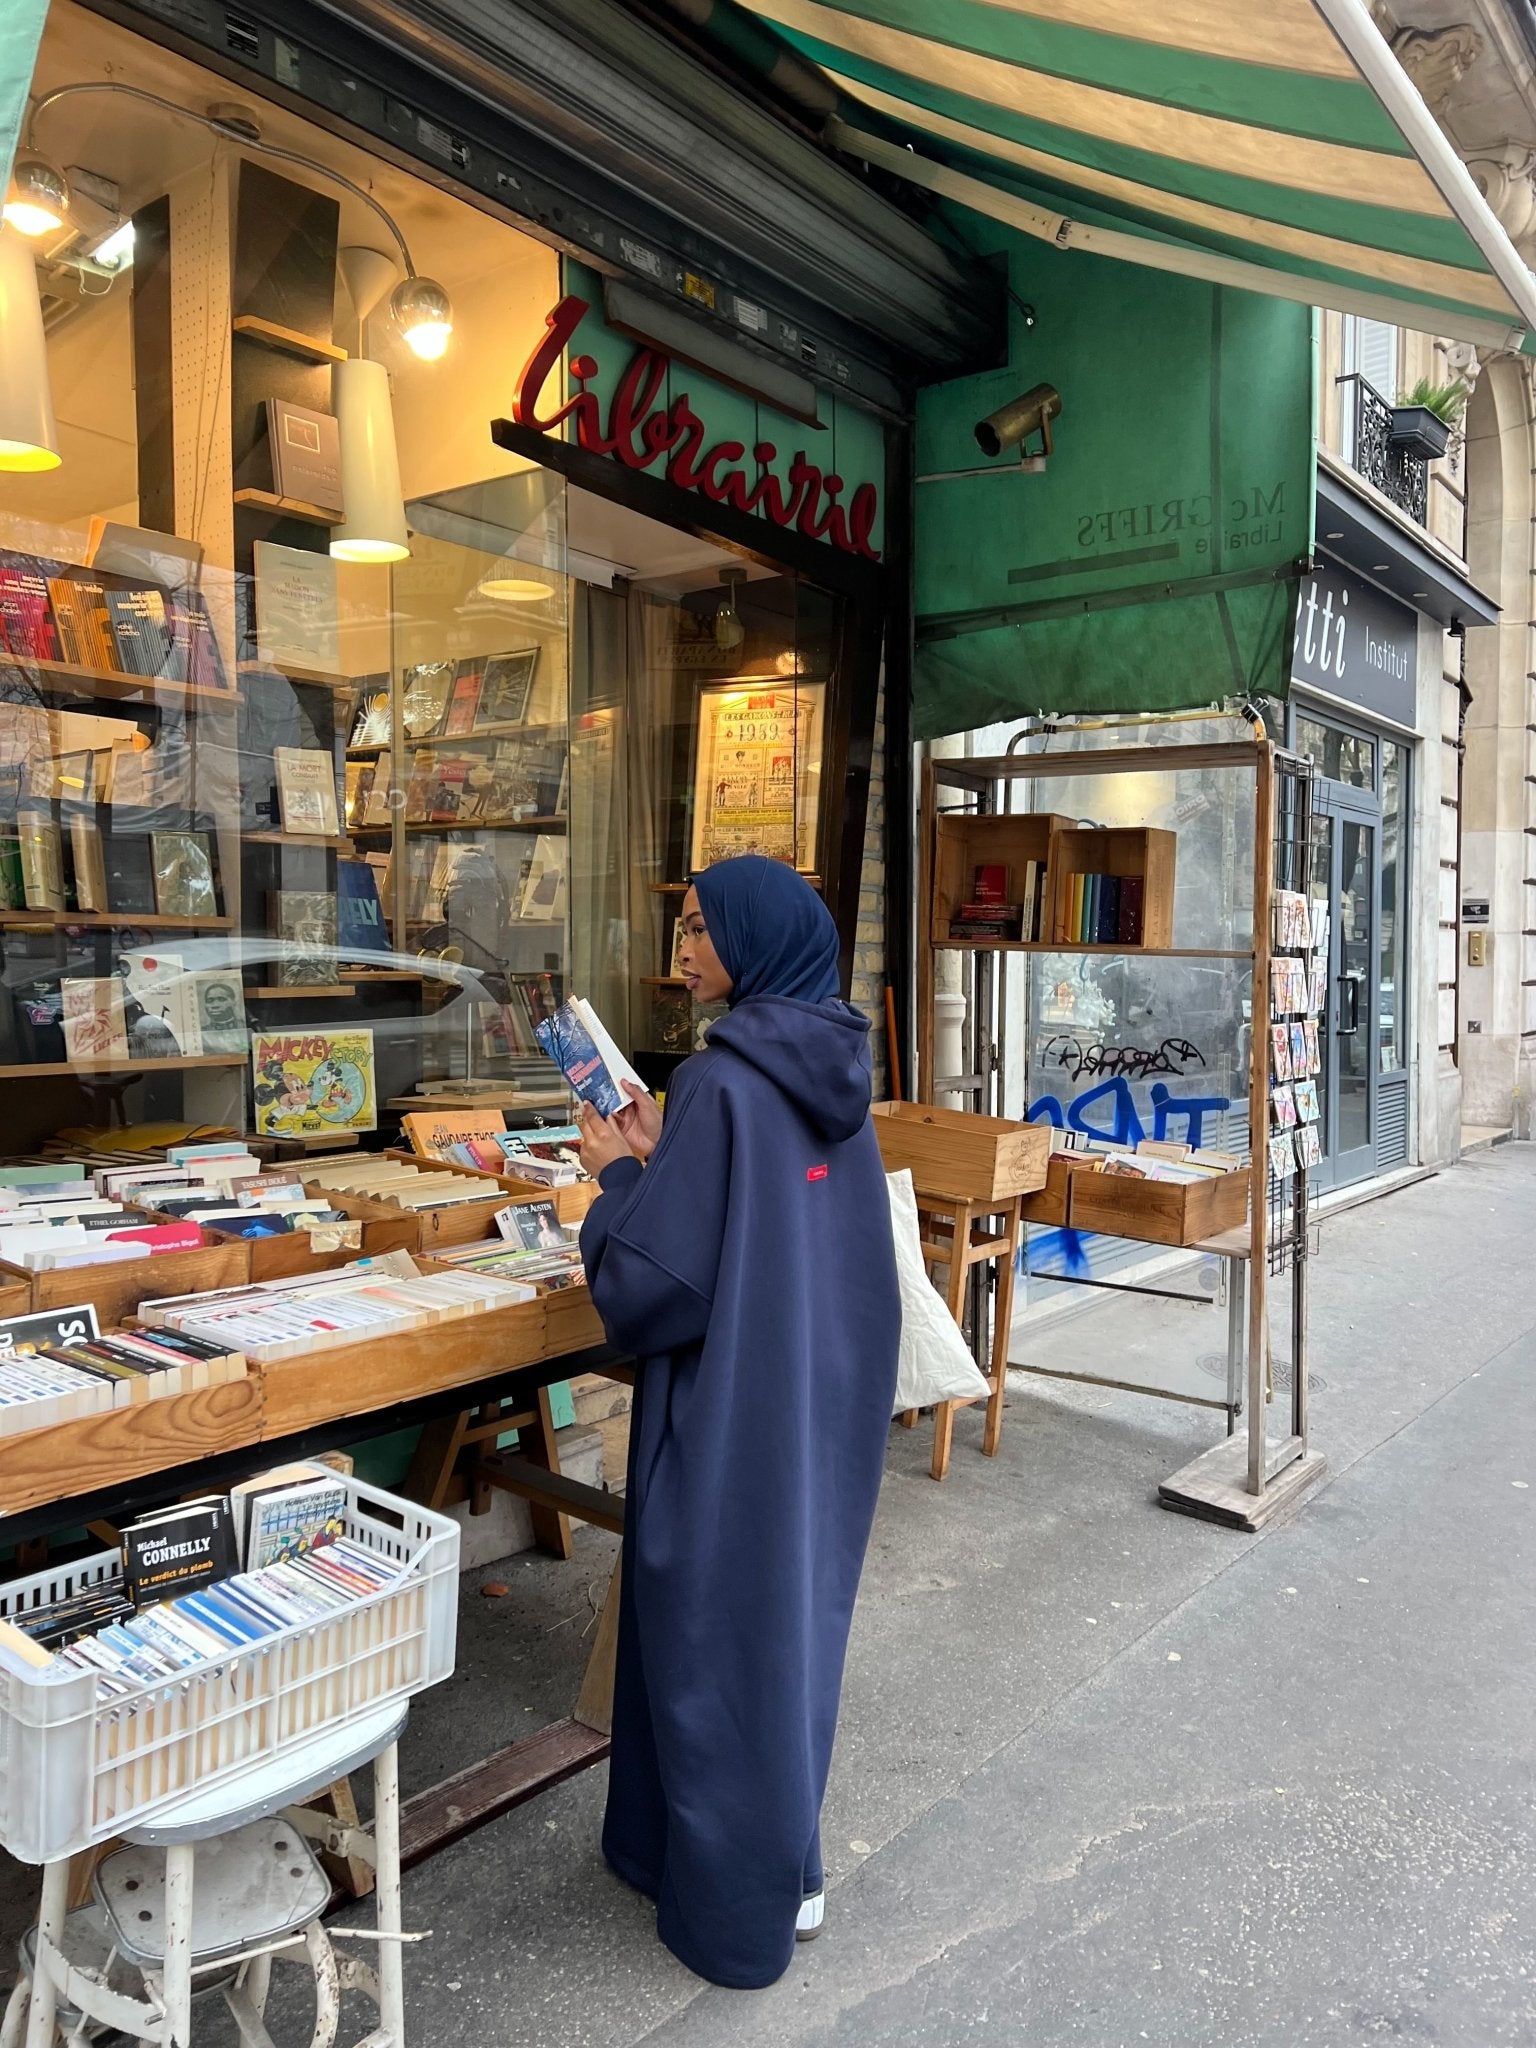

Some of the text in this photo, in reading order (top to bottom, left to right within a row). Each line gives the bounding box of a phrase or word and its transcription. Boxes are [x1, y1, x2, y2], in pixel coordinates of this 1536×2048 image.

[1365, 626, 1408, 682] Institut
[257, 1035, 373, 1073] MICKEY STORY
[514, 1203, 552, 1215] JANE AUSTEN
[137, 1537, 167, 1553] Michael
[142, 1537, 211, 1567] CONNELLY
[139, 1577, 149, 1586] Le
[150, 1569, 177, 1584] verdict
[178, 1567, 190, 1577] du
[190, 1560, 214, 1575] plomb
